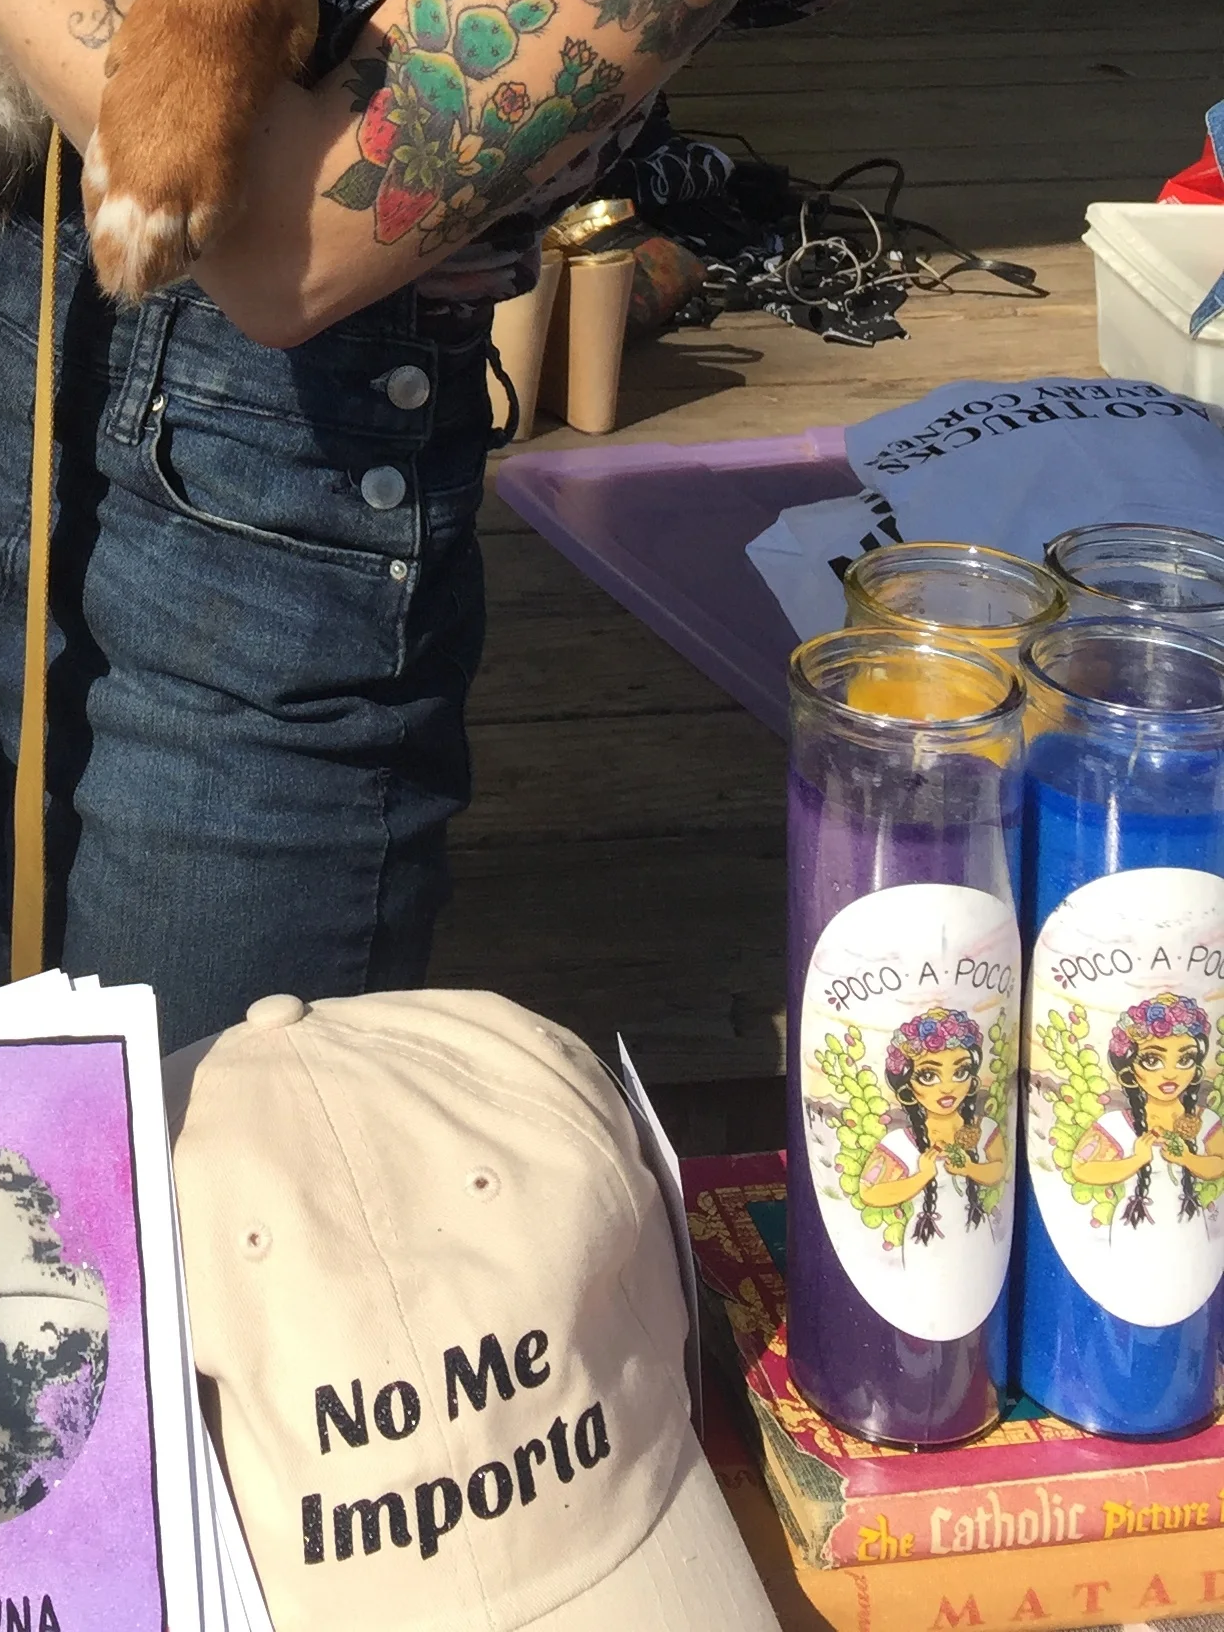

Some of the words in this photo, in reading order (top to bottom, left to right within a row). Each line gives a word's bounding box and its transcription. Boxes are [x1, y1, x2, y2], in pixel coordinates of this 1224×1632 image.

[1035, 384, 1167, 401] EVERY
[1102, 401, 1211, 423] ACO
[877, 399, 1100, 475] TRUCKS
[831, 965, 903, 1010] POCO
[918, 961, 940, 986] A
[954, 957, 1012, 994] POCO
[1059, 948, 1134, 989] POCO
[1150, 946, 1172, 971] A
[312, 1377, 422, 1456] No
[442, 1328, 552, 1423] Me
[299, 1401, 613, 1566] Importa
[929, 1485, 1087, 1555] Catholic
